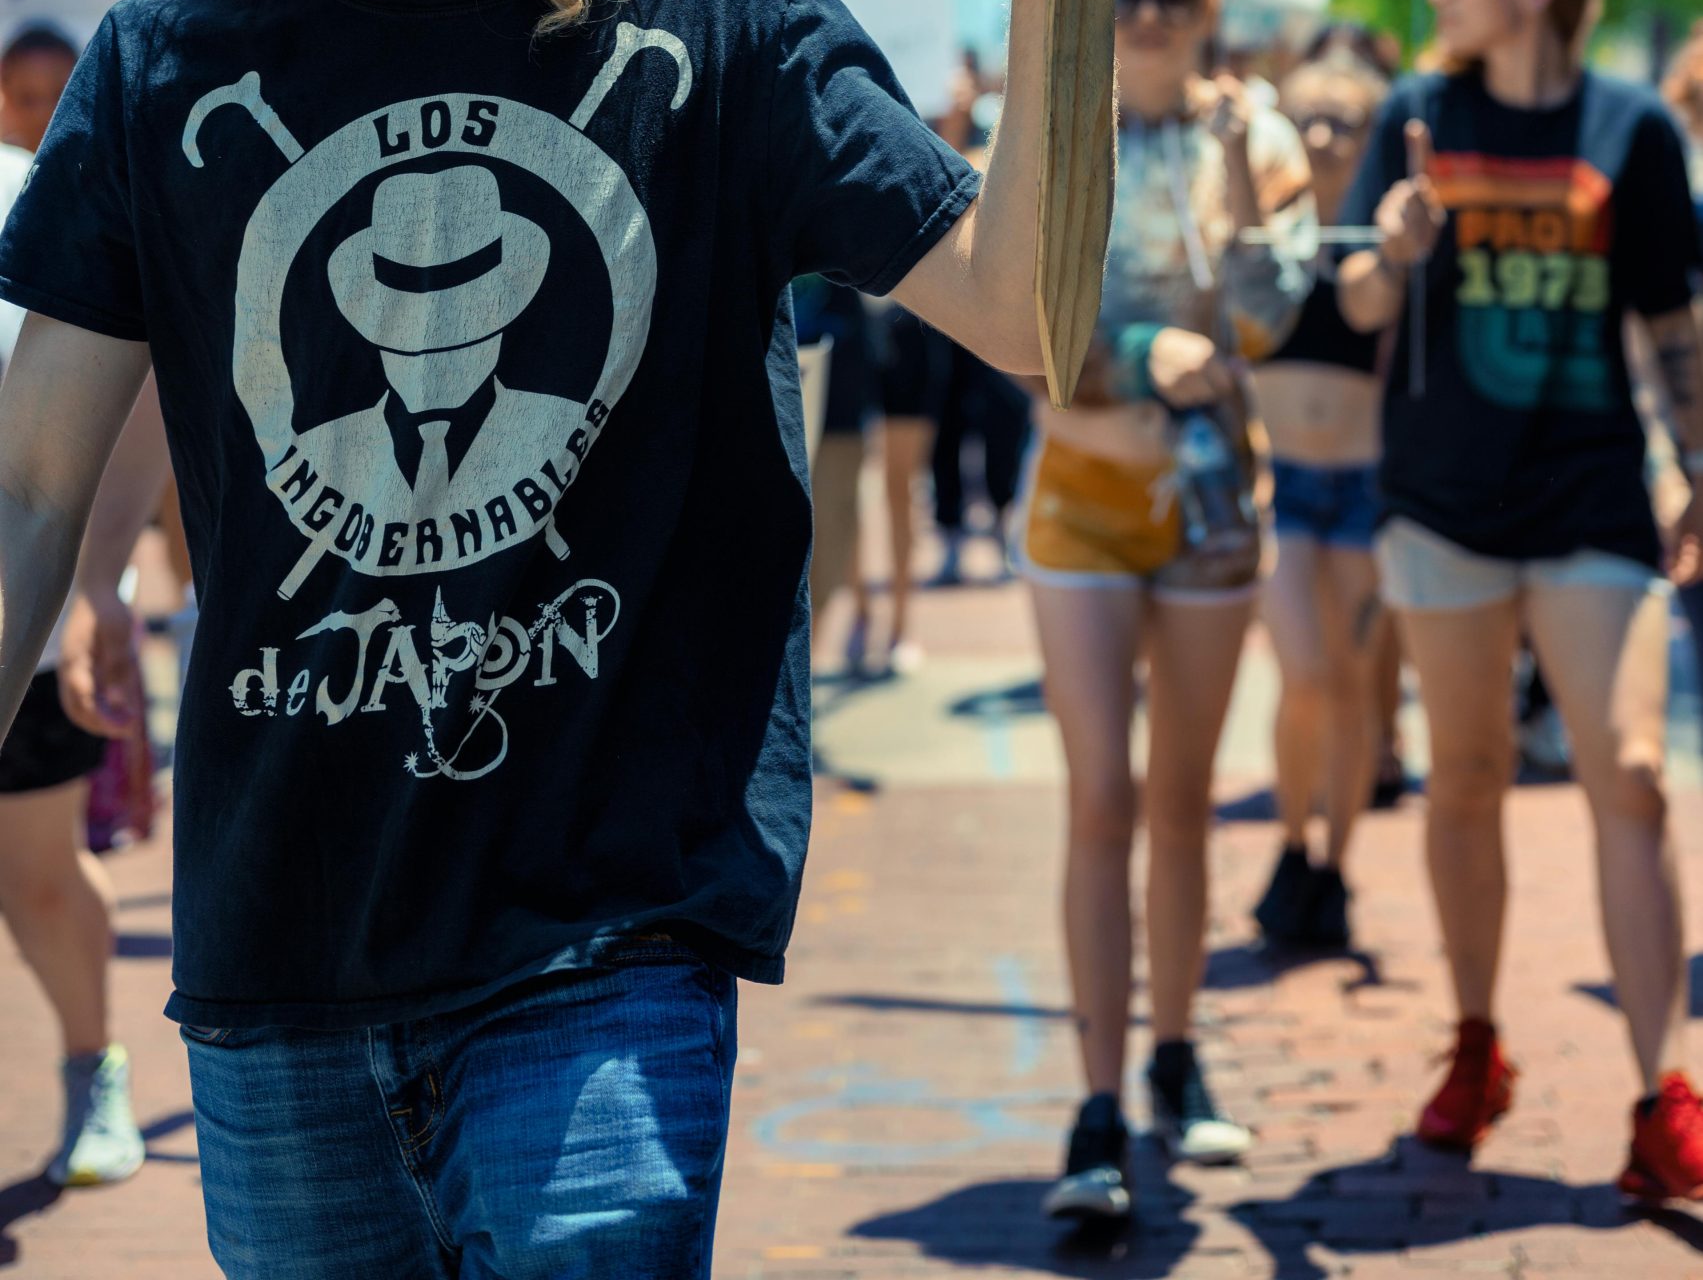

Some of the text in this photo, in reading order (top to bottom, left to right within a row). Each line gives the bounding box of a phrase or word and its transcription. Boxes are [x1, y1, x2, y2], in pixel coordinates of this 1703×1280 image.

[373, 100, 499, 158] LOS
[269, 398, 610, 567] INGOBERNABLES
[228, 580, 622, 730] de JAPON
